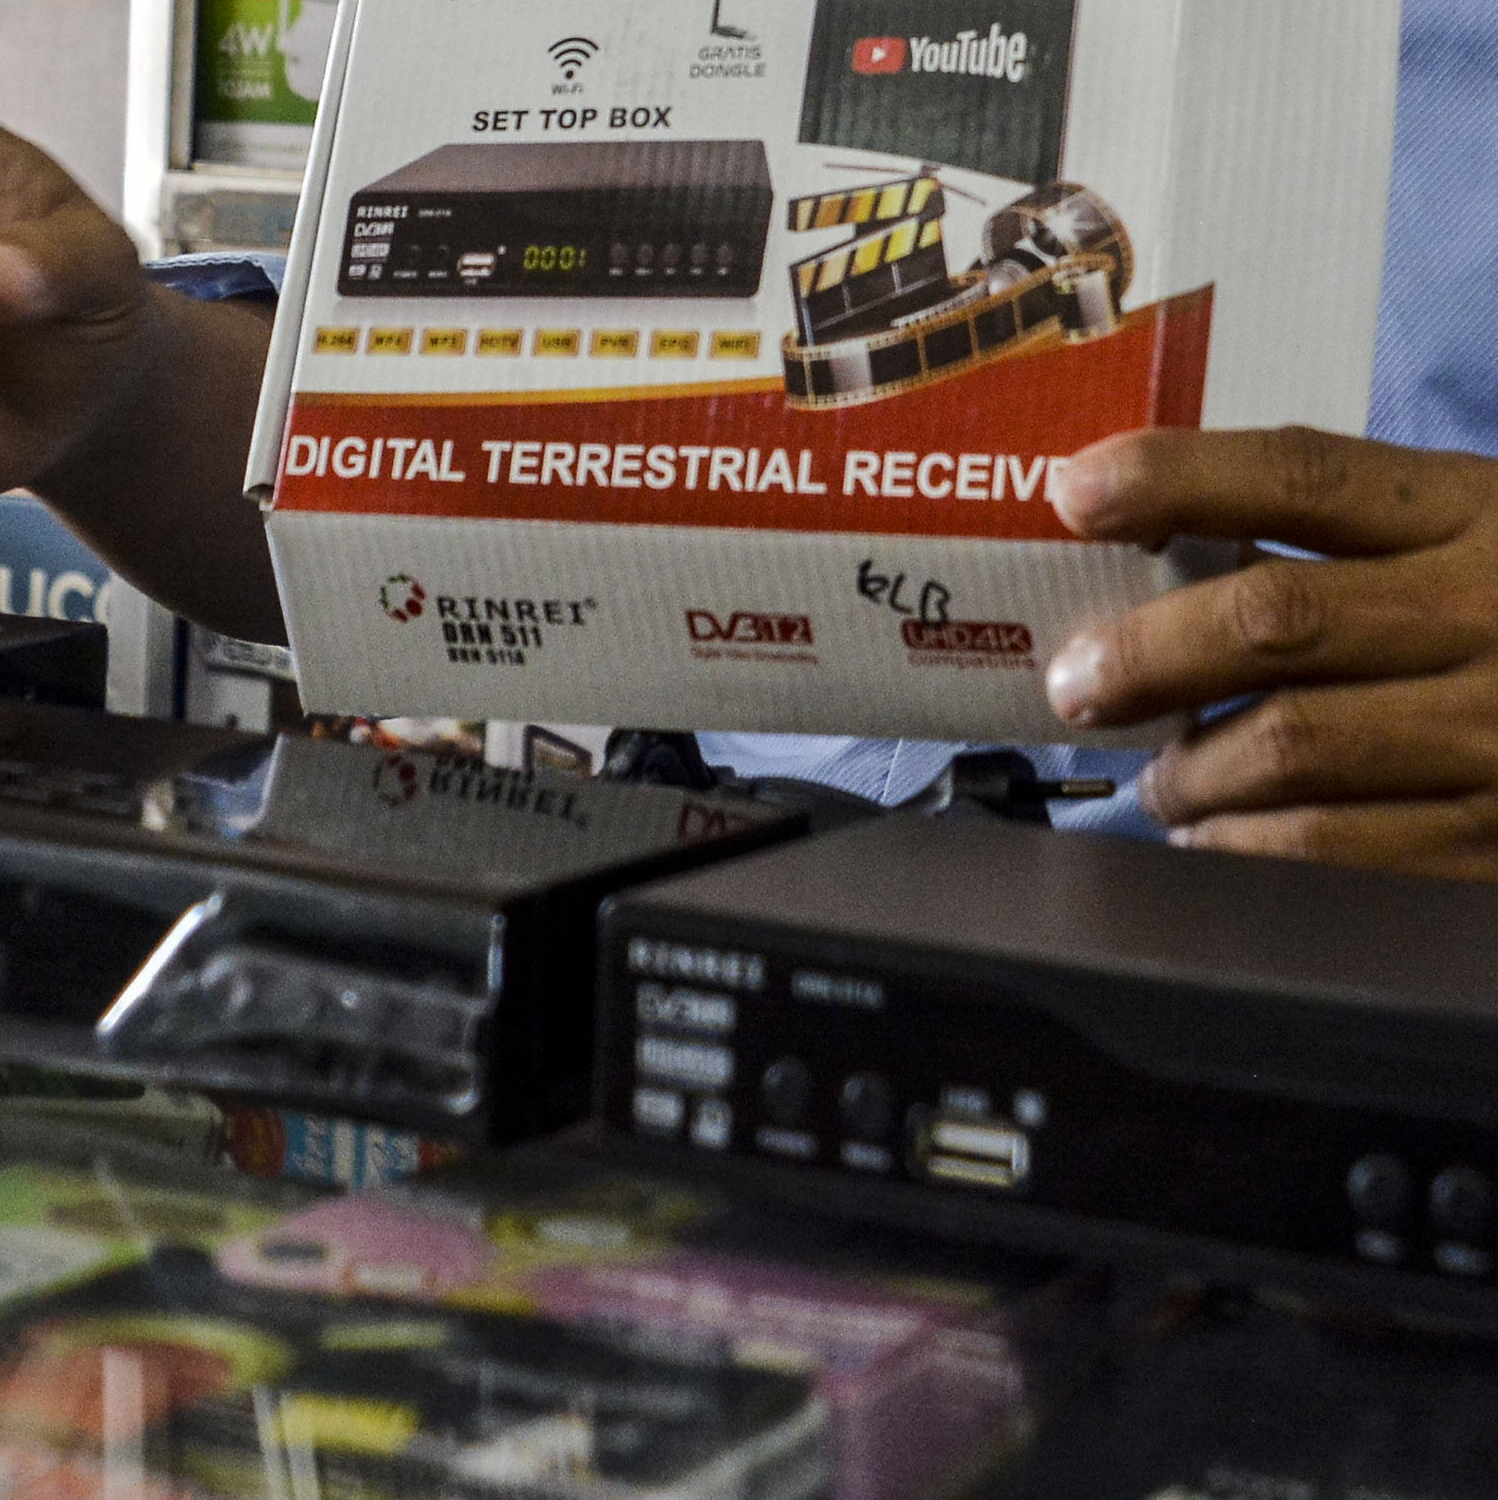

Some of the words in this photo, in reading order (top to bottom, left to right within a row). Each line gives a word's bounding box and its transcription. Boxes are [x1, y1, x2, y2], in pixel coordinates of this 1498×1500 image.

[697, 47, 763, 61] GRATIS
[908, 21, 1029, 83] YouTube
[689, 63, 767, 80] DONGLE
[471, 110, 529, 133] SET
[538, 108, 598, 130] TOP
[608, 106, 673, 129] BOX
[356, 204, 410, 219] RINREI
[522, 244, 588, 272] 0001
[285, 434, 466, 483] DIGITAL
[481, 439, 828, 496] TERRESTRIAL
[435, 595, 586, 626] RINREI
[499, 624, 544, 648] 511
